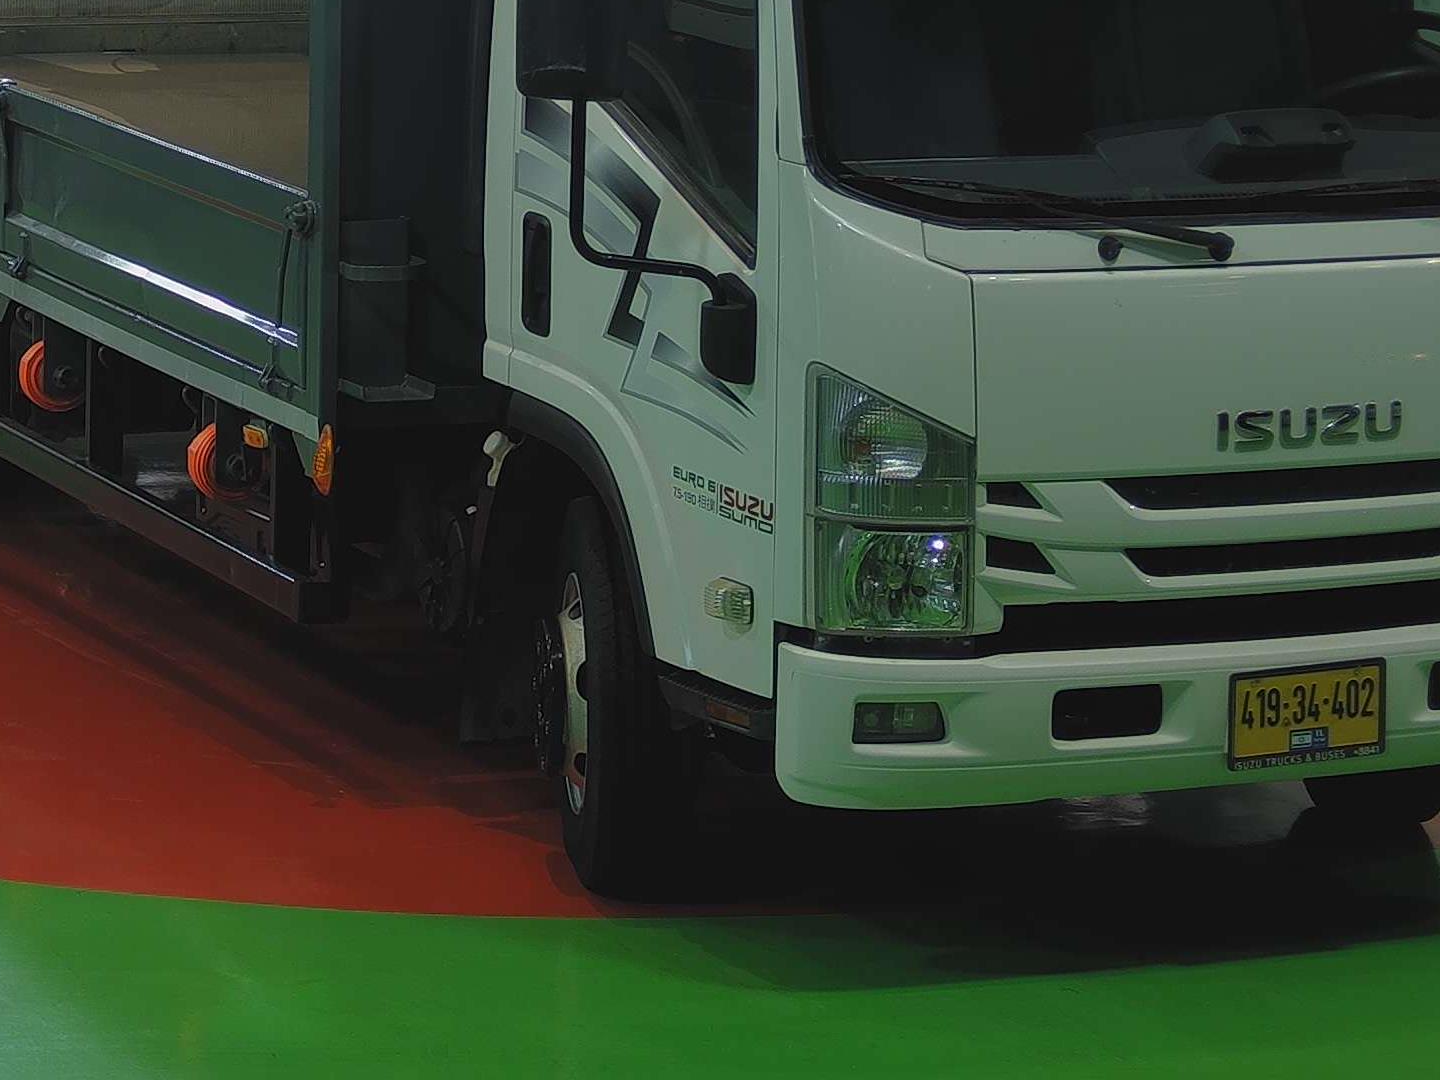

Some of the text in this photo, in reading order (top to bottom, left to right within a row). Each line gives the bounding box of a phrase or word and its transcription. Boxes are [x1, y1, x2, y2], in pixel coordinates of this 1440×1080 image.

[1216, 400, 1403, 454] ISUZU
[672, 465, 717, 494] EURO 6
[719, 484, 775, 521] ISUZU
[718, 505, 775, 536] SUMO
[1266, 754, 1303, 768] TRUCKS
[1315, 750, 1346, 762] BUSES
